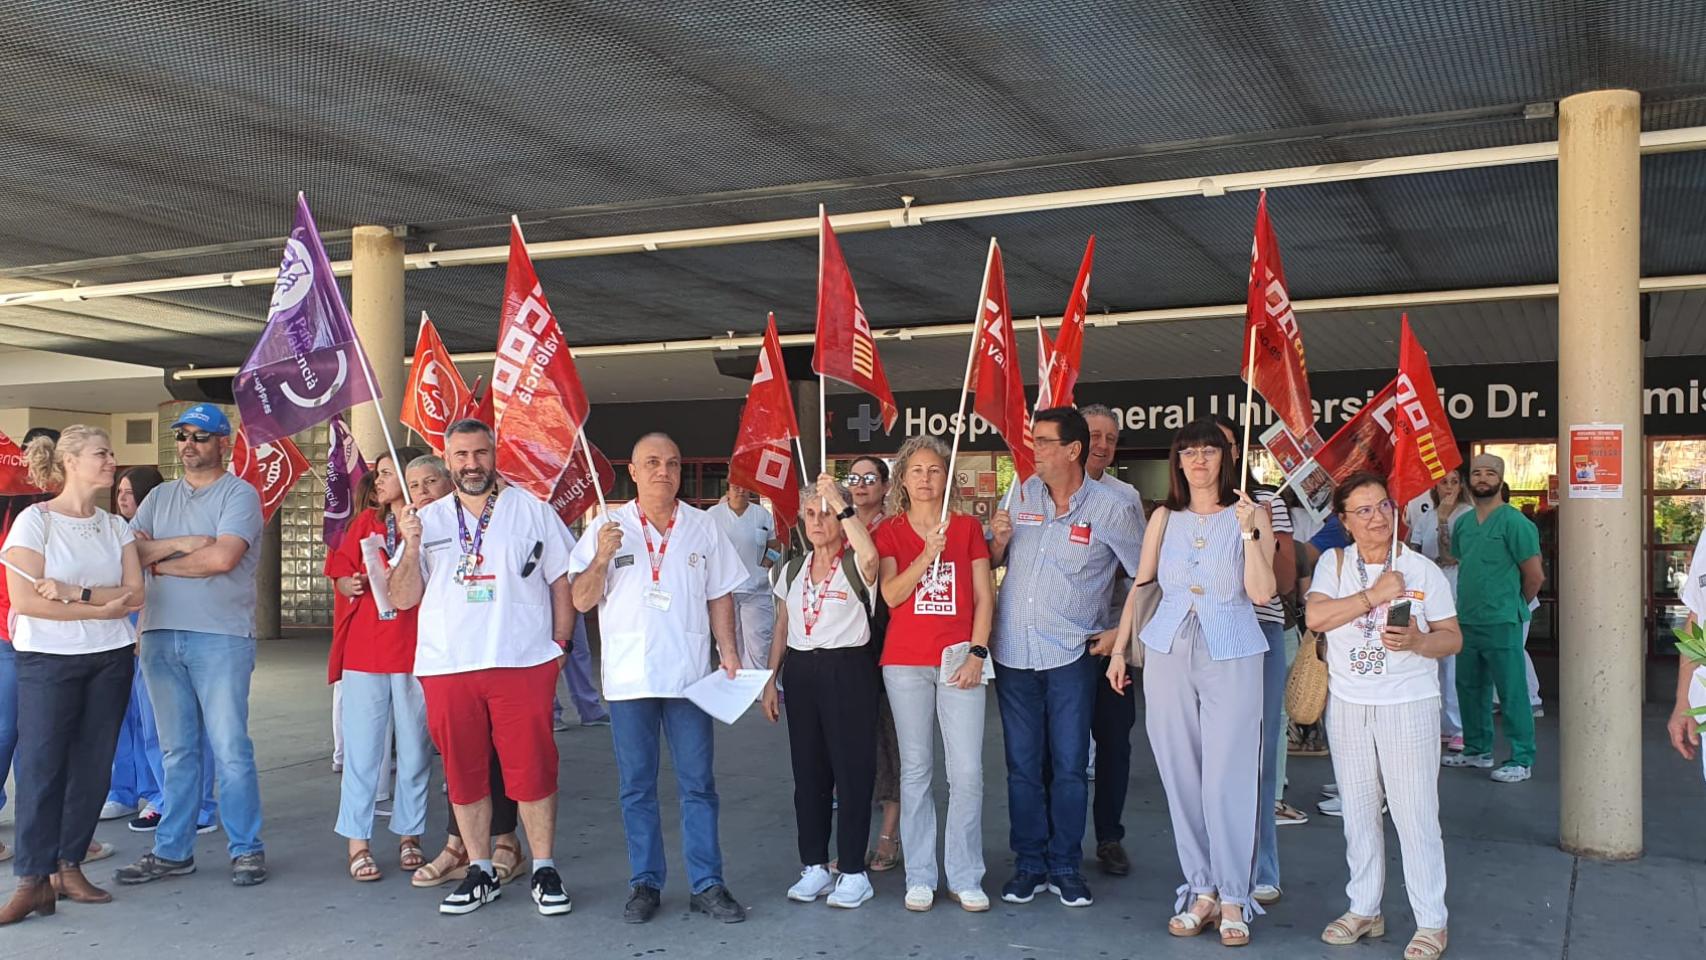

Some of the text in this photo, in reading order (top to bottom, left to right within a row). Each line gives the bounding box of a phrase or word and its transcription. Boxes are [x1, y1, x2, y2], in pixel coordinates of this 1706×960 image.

[295, 316, 314, 350] País
[1487, 383, 1546, 418] Dr.
[916, 603, 953, 612] CCOO
